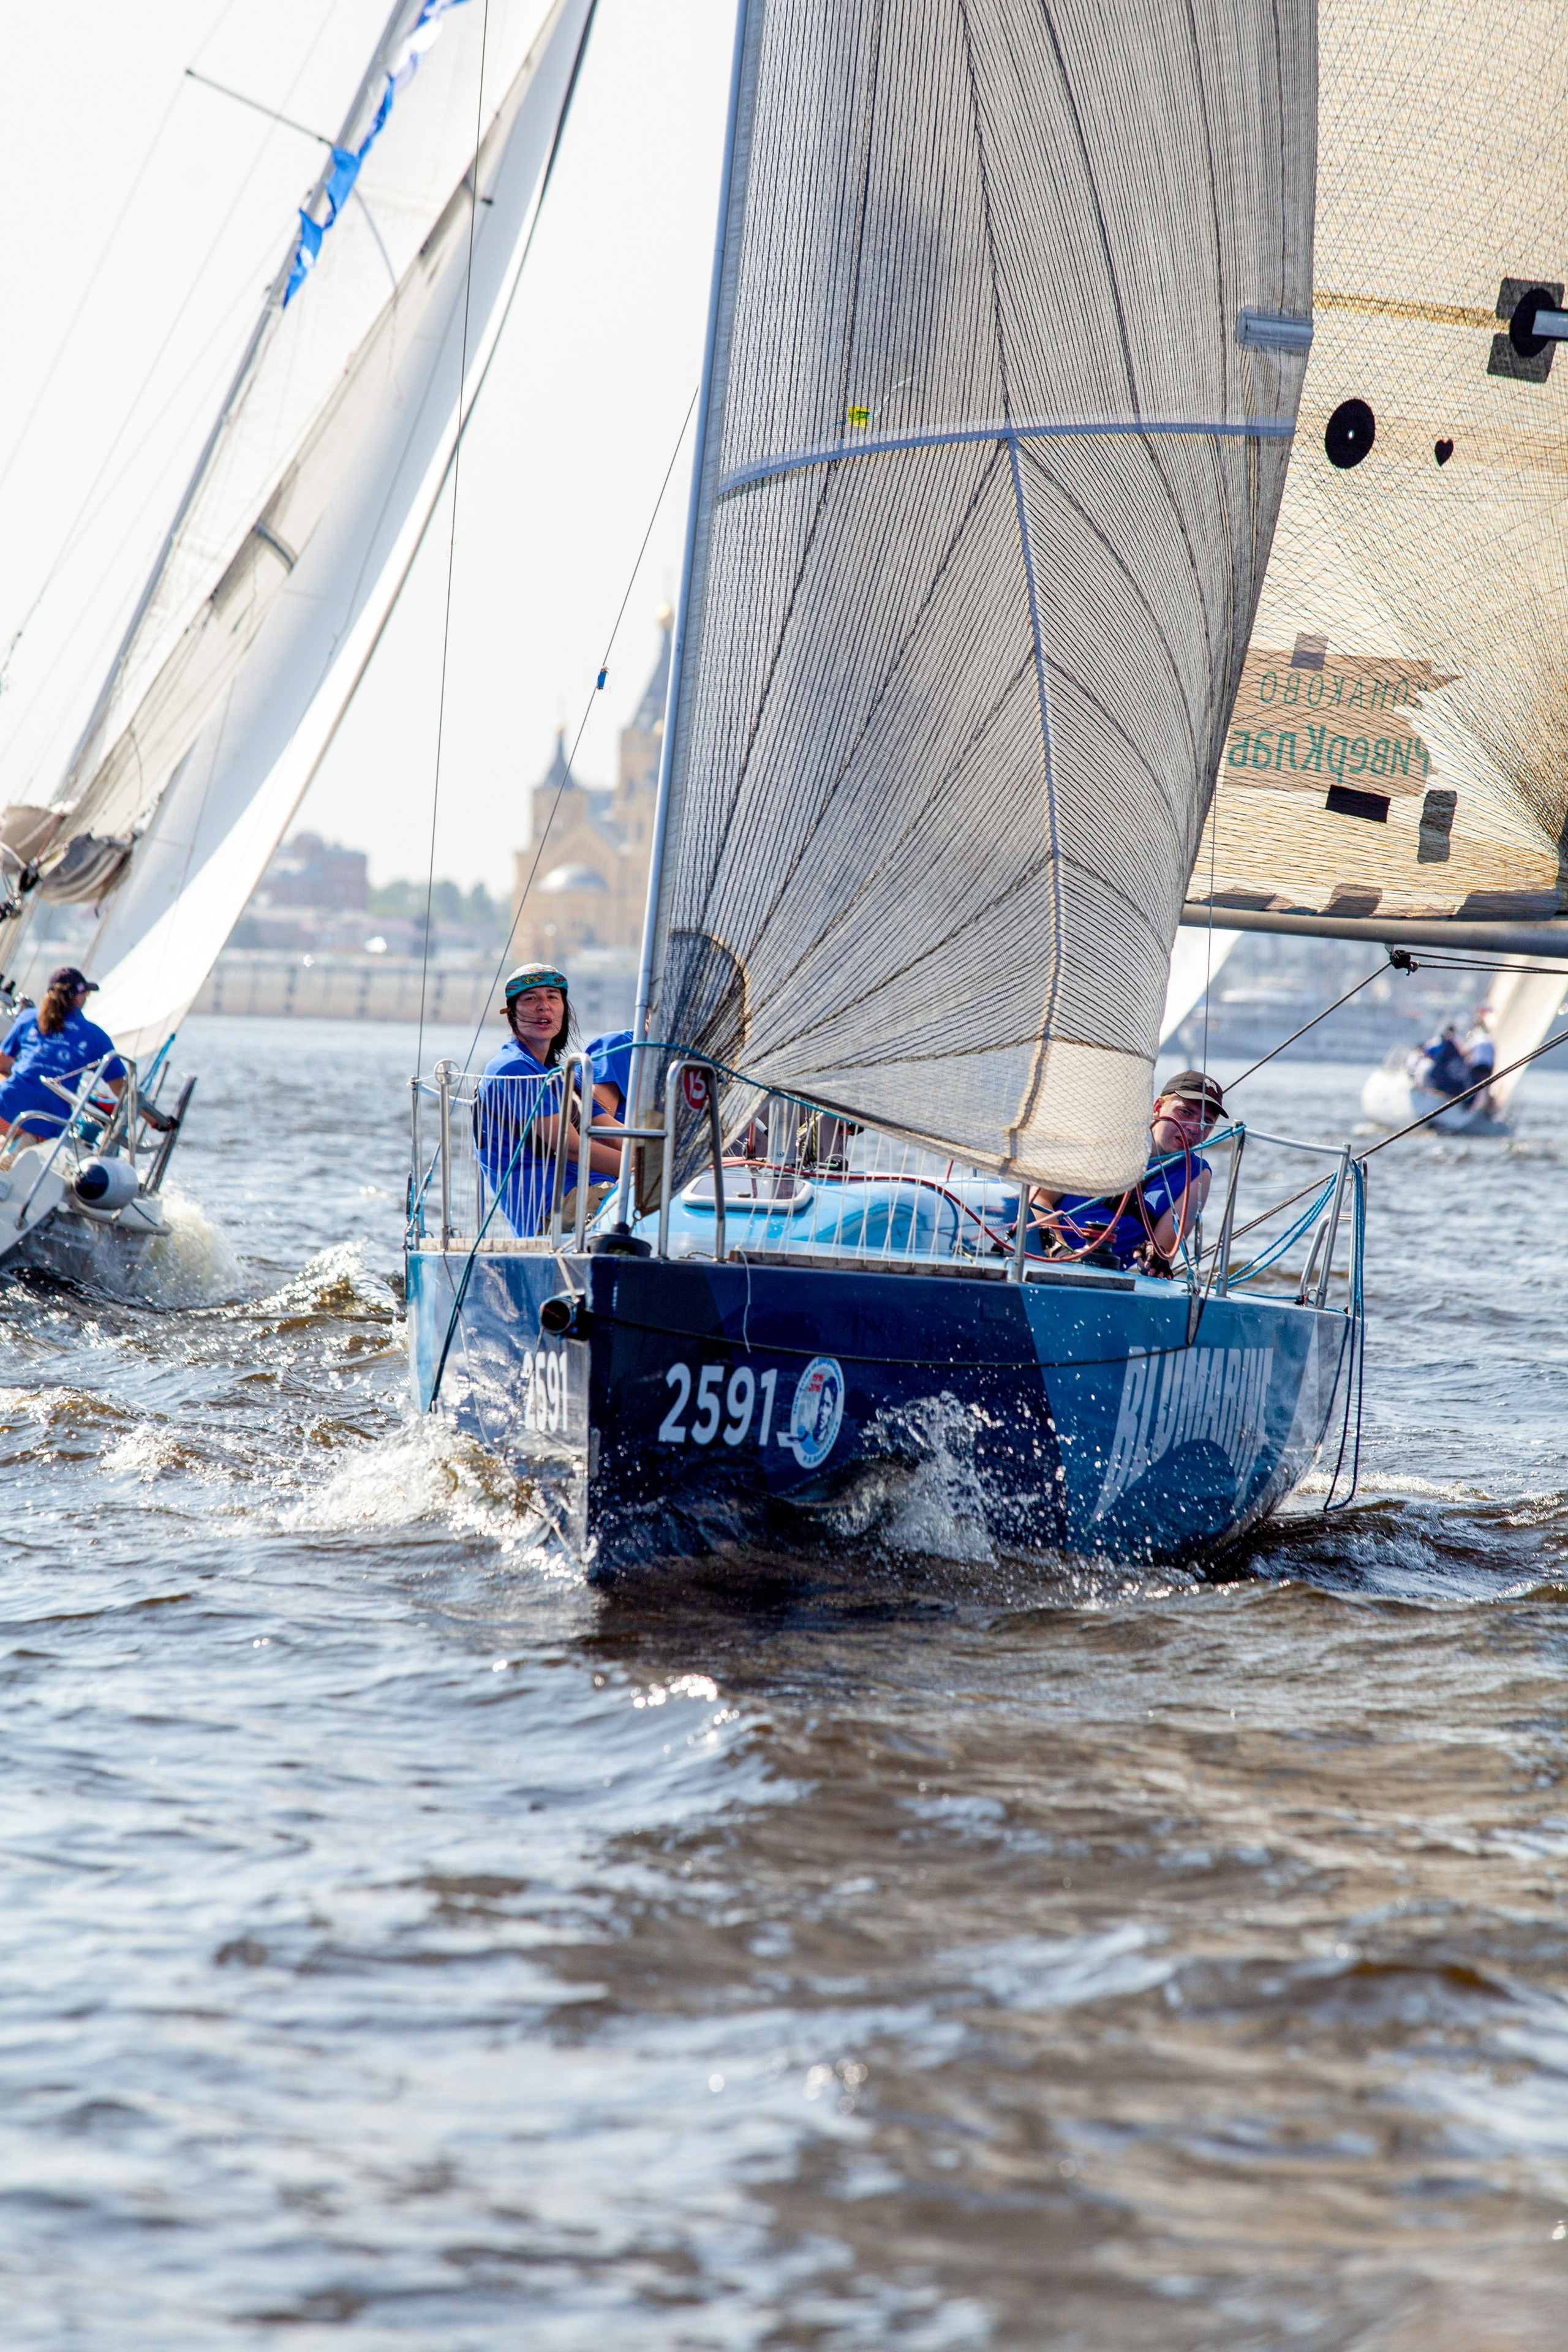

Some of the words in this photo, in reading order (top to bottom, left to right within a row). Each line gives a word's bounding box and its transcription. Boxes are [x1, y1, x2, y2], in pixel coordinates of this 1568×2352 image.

[522, 1351, 568, 1432] 2591
[658, 1362, 778, 1446] 2591
[1084, 1346, 1274, 1531] BLUMARINE
